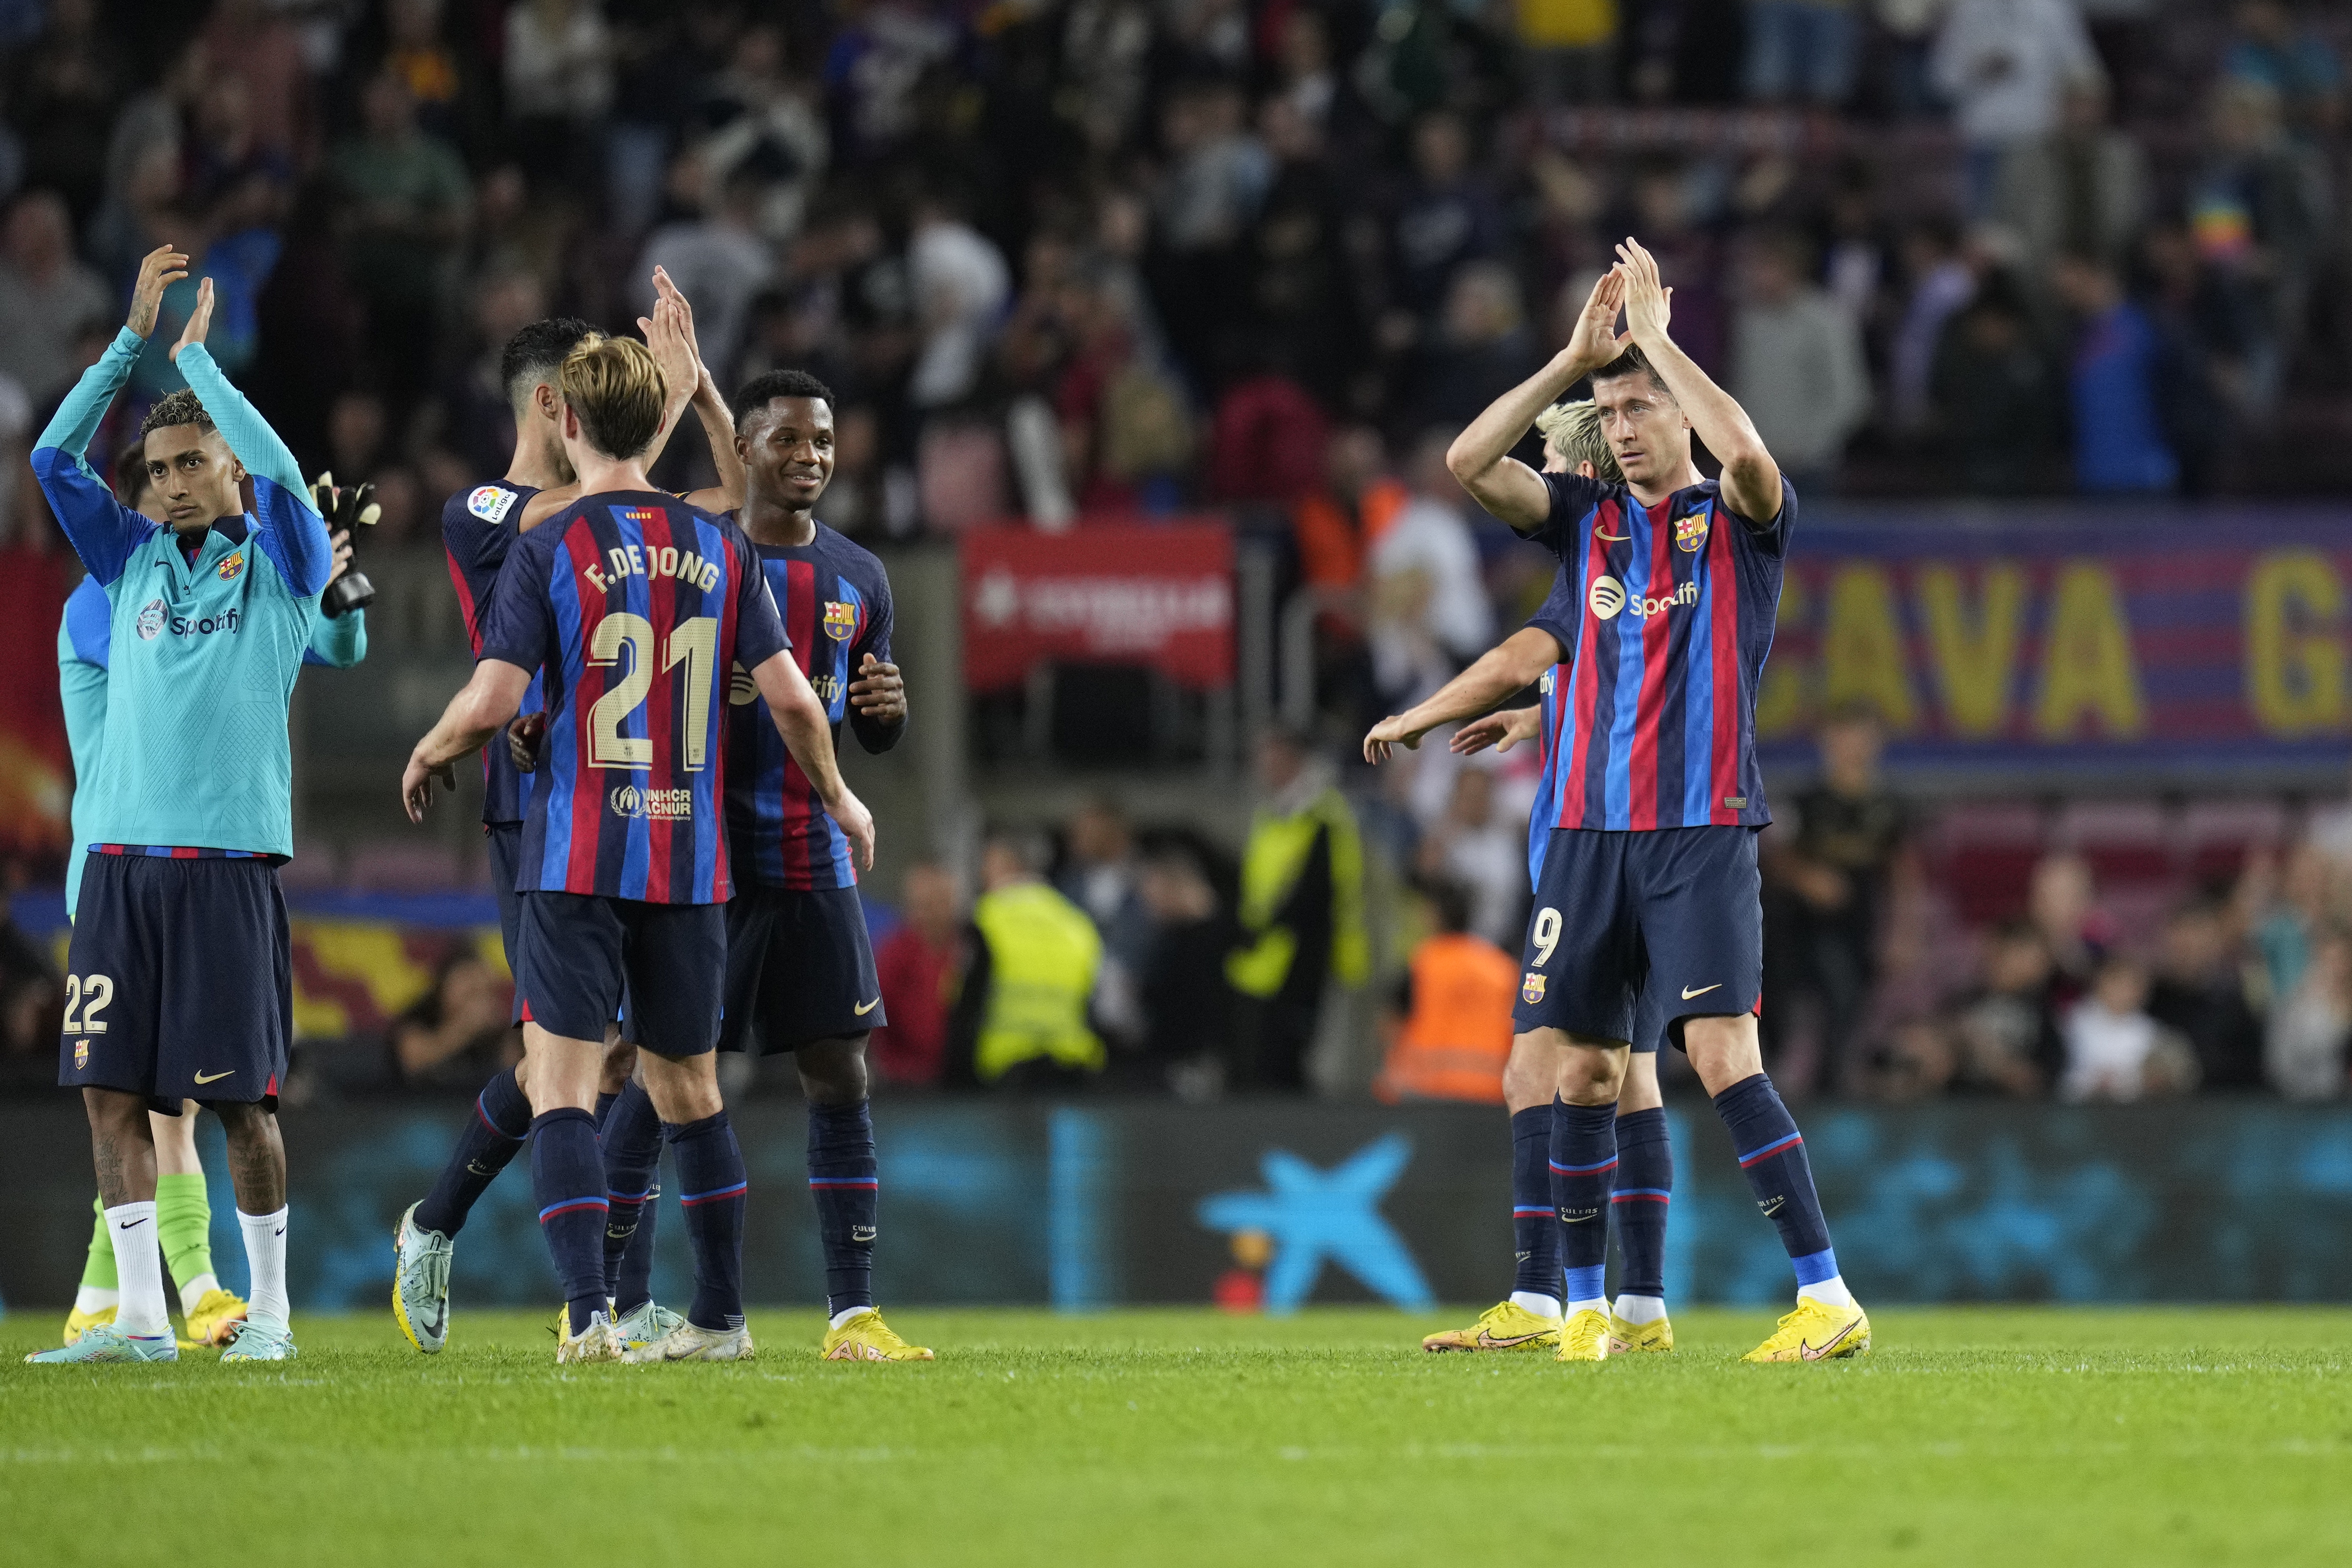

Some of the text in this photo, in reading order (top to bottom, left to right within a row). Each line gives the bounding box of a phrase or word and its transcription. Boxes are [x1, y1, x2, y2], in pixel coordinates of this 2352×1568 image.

[492, 494, 510, 520] LaLiga
[646, 546, 719, 593] JONG
[170, 608, 240, 639] Spotify
[587, 612, 718, 772] 21
[812, 675, 845, 703] tify
[1531, 907, 1562, 967] 9
[63, 974, 113, 1034] 22
[1561, 1207, 1598, 1215] CULERS
